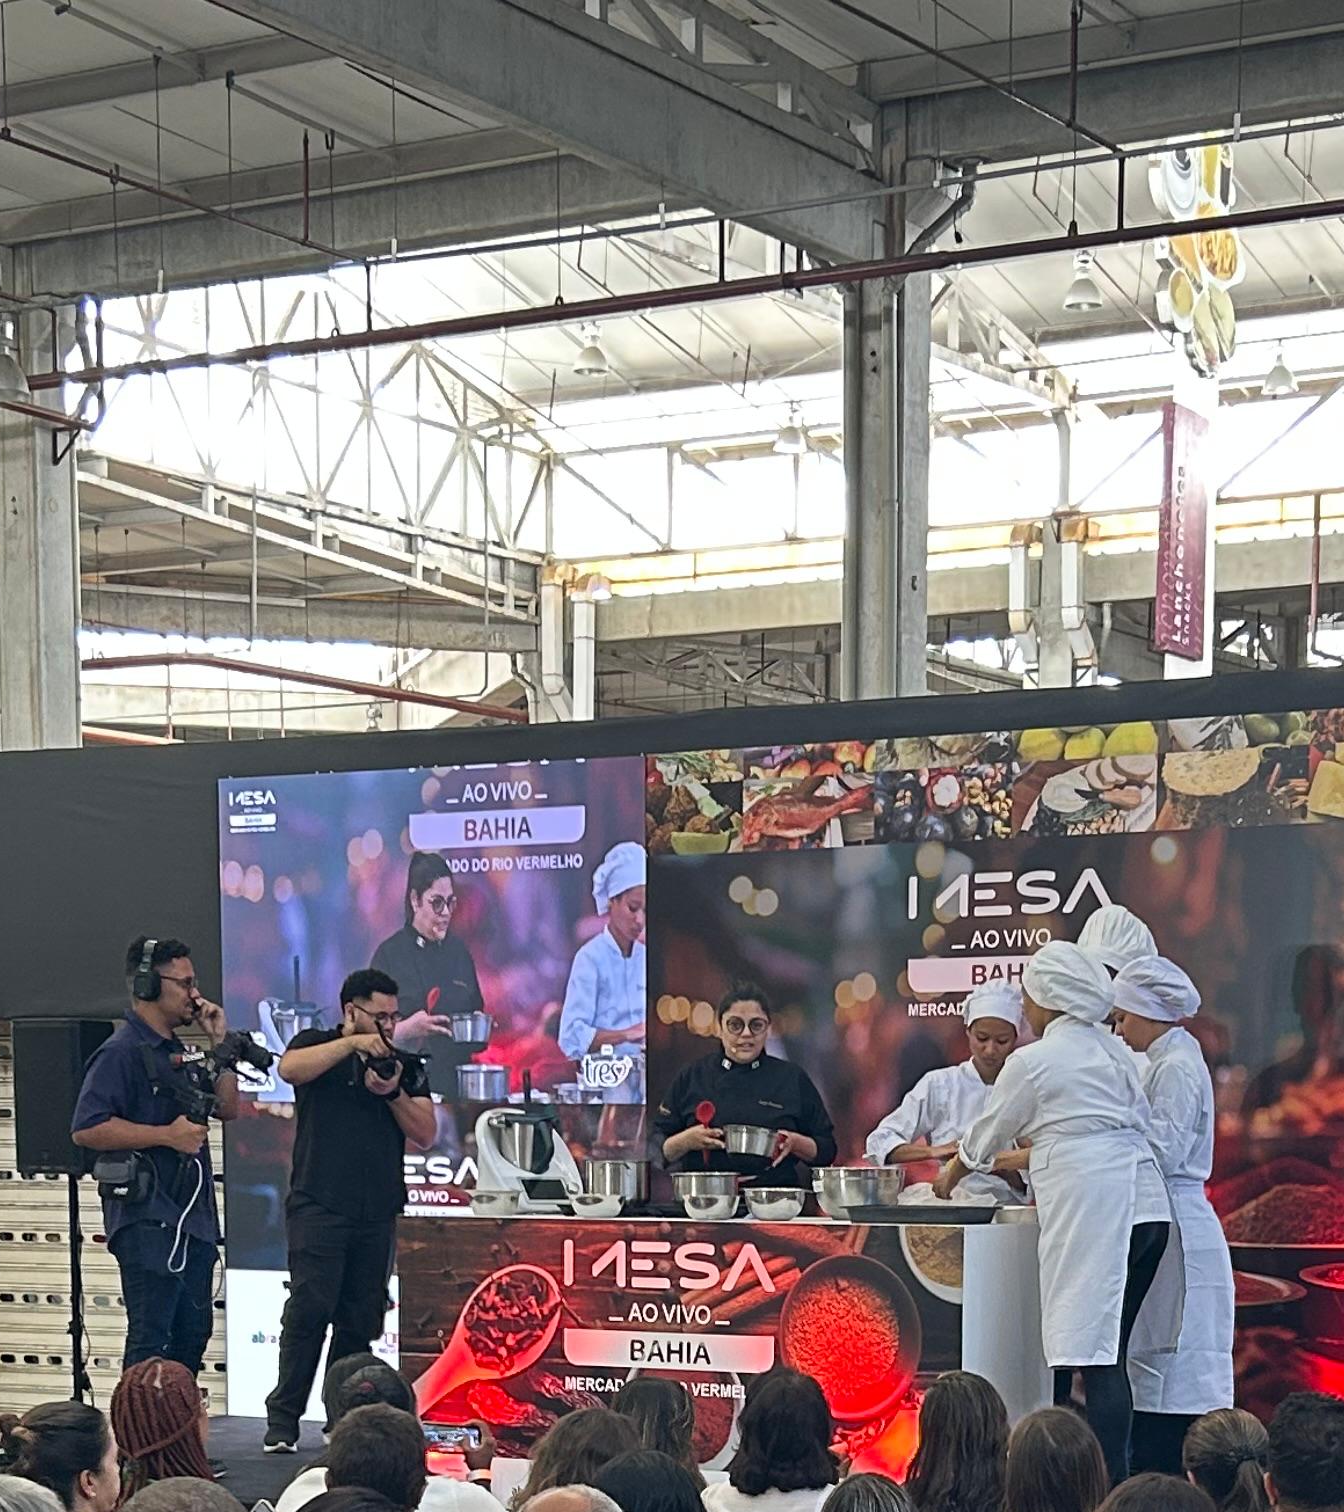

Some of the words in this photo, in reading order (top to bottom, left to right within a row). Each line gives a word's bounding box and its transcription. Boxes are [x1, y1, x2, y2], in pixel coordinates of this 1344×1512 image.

[462, 783, 487, 803] AO
[489, 780, 532, 800] VIVO
[464, 816, 532, 841] BAHIA
[471, 858, 490, 872] DO
[491, 857, 514, 871] RIO
[514, 853, 584, 871] VERMELHO
[907, 867, 1113, 920] MESA
[970, 929, 1000, 949] AO
[1002, 928, 1052, 947] VIVO
[971, 962, 1030, 986] BAH
[908, 1001, 965, 1017] MERCAD
[403, 1154, 479, 1185] ESA
[419, 1189, 449, 1204] VIVO
[563, 1239, 776, 1293] MESA
[627, 1302, 659, 1323] AO
[661, 1303, 711, 1325] VIVO
[629, 1339, 711, 1365] BAHIA
[564, 1375, 626, 1393] MERCAD
[691, 1381, 747, 1400] VERMEL
